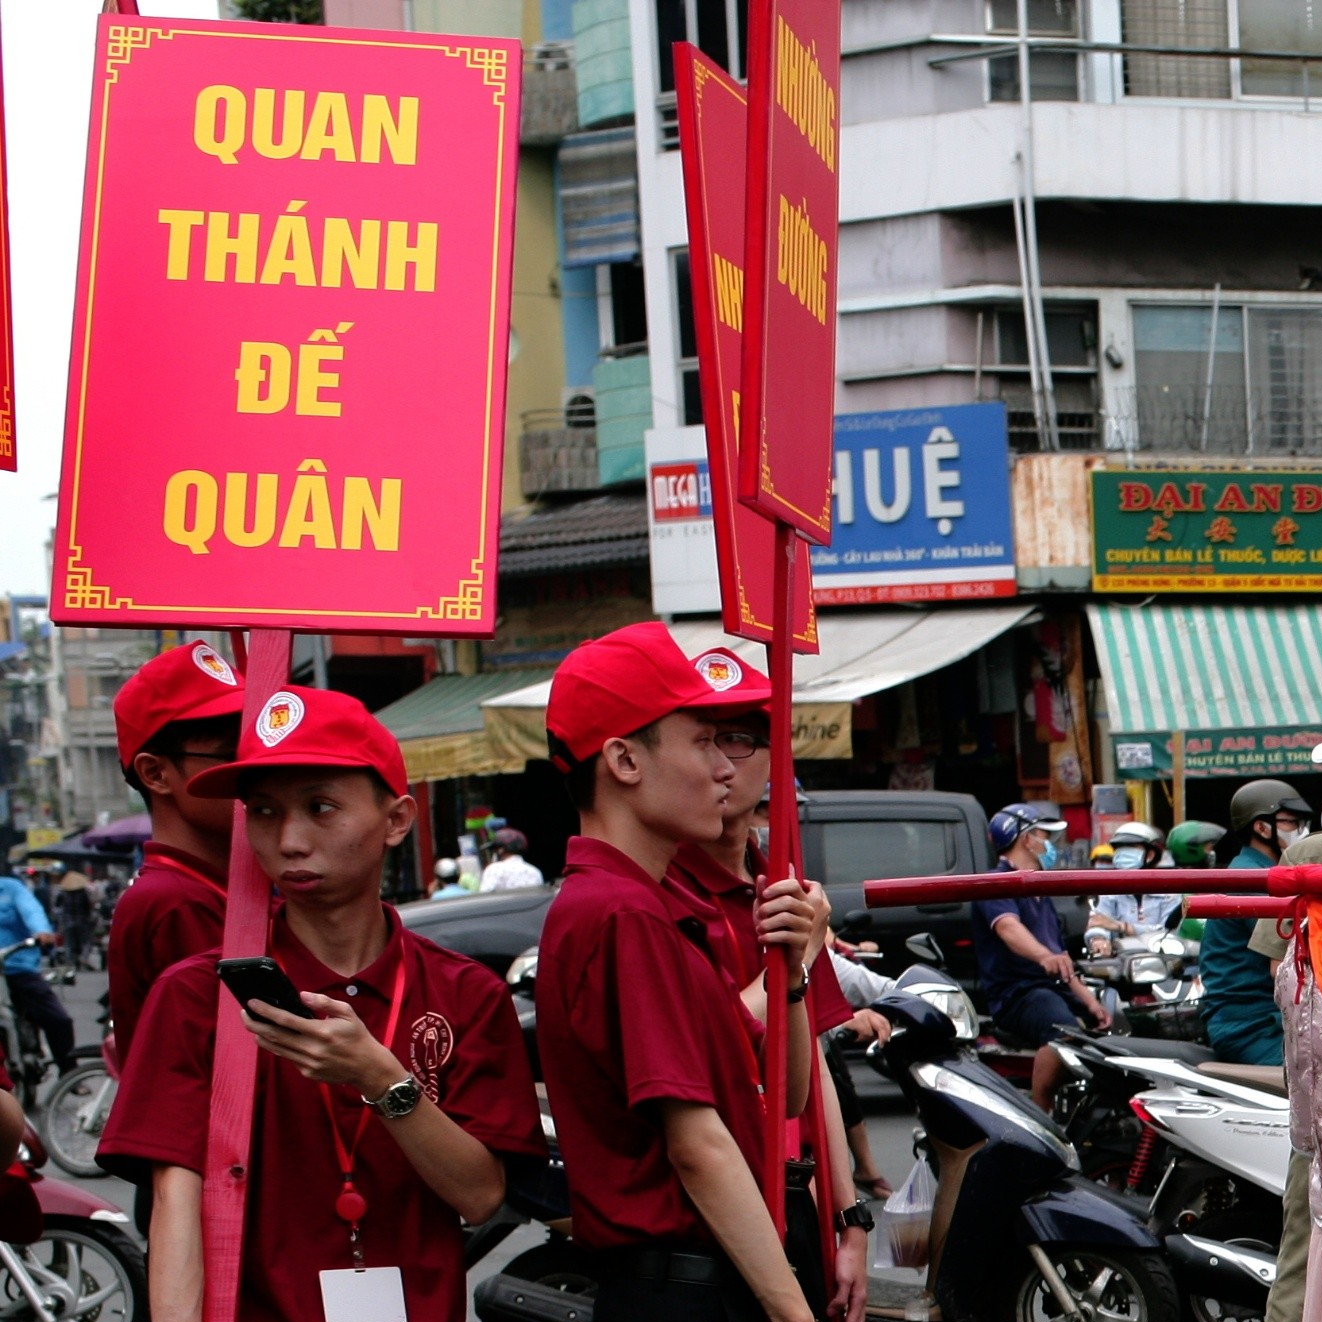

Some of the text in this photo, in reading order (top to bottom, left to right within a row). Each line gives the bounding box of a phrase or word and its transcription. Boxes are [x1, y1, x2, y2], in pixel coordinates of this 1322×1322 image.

[193, 84, 420, 166] QUAN
[778, 14, 835, 173] NHƯỜNG
[159, 201, 438, 292] THÁNH
[778, 194, 827, 326] ĐƯỜNG
[234, 322, 354, 418] ĐẾ
[162, 459, 403, 555] QUÂN
[1118, 482, 1206, 518] ĐẠI
[1214, 483, 1282, 512] AN
[1106, 547, 1160, 562] CHUYÊN
[1165, 547, 1193, 562] BÁN
[1185, 750, 1234, 767] HUYÊN
[1220, 736, 1256, 750] AN
